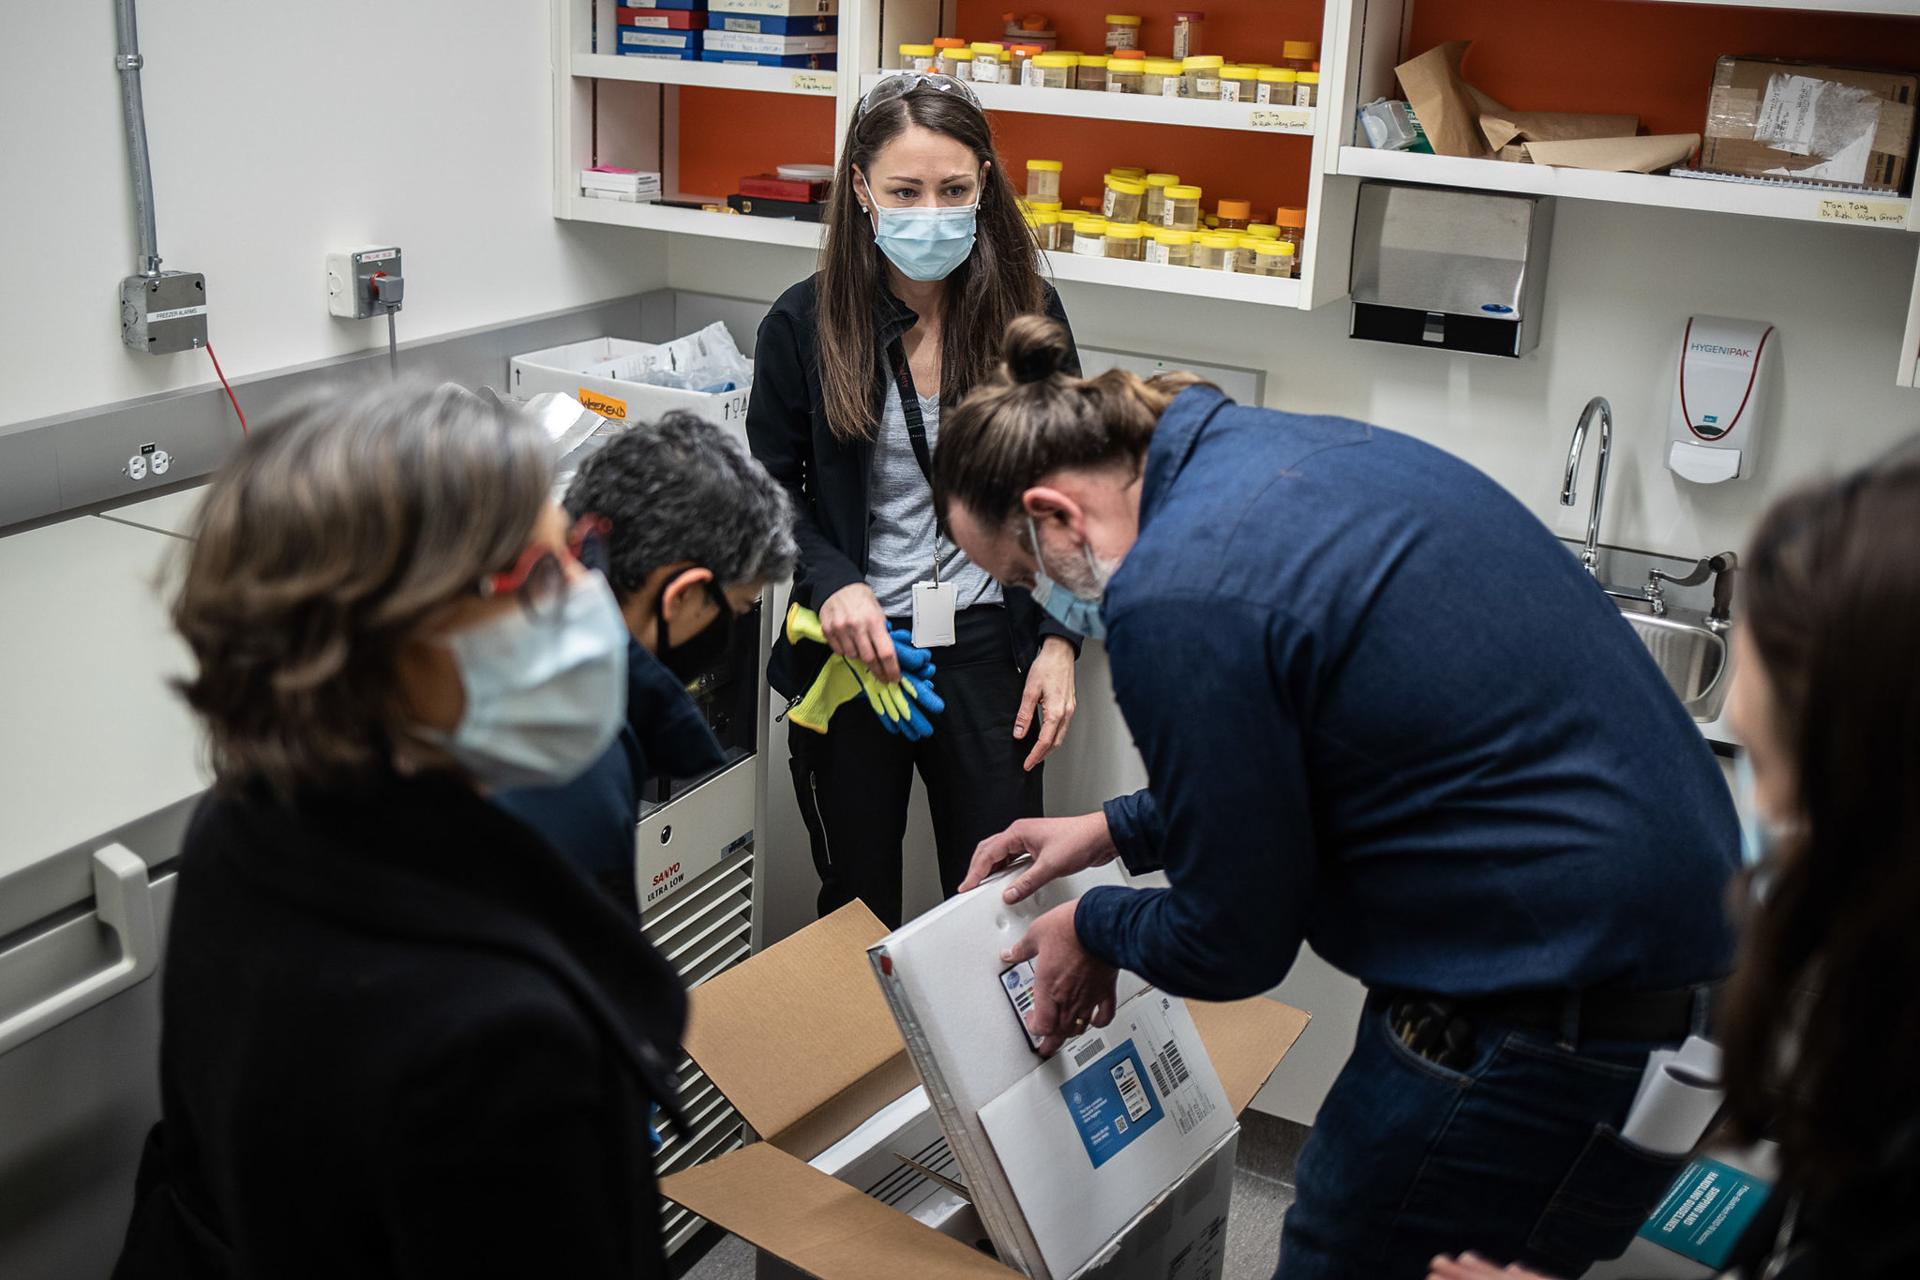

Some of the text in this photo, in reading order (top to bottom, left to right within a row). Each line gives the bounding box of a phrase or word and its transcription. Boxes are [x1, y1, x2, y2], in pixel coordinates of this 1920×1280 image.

[156, 311, 178, 319] FREEZER
[1691, 342, 1751, 358] HYGENIPAK
[579, 396, 626, 418] WEEKEND
[653, 863, 680, 886] SANYO
[648, 874, 684, 901] ULTRA LOW
[1688, 1171, 1718, 1201] HANDLING
[1661, 1198, 1696, 1232] GUIDELINES
[1682, 1186, 1720, 1226] SHIPPING AND
